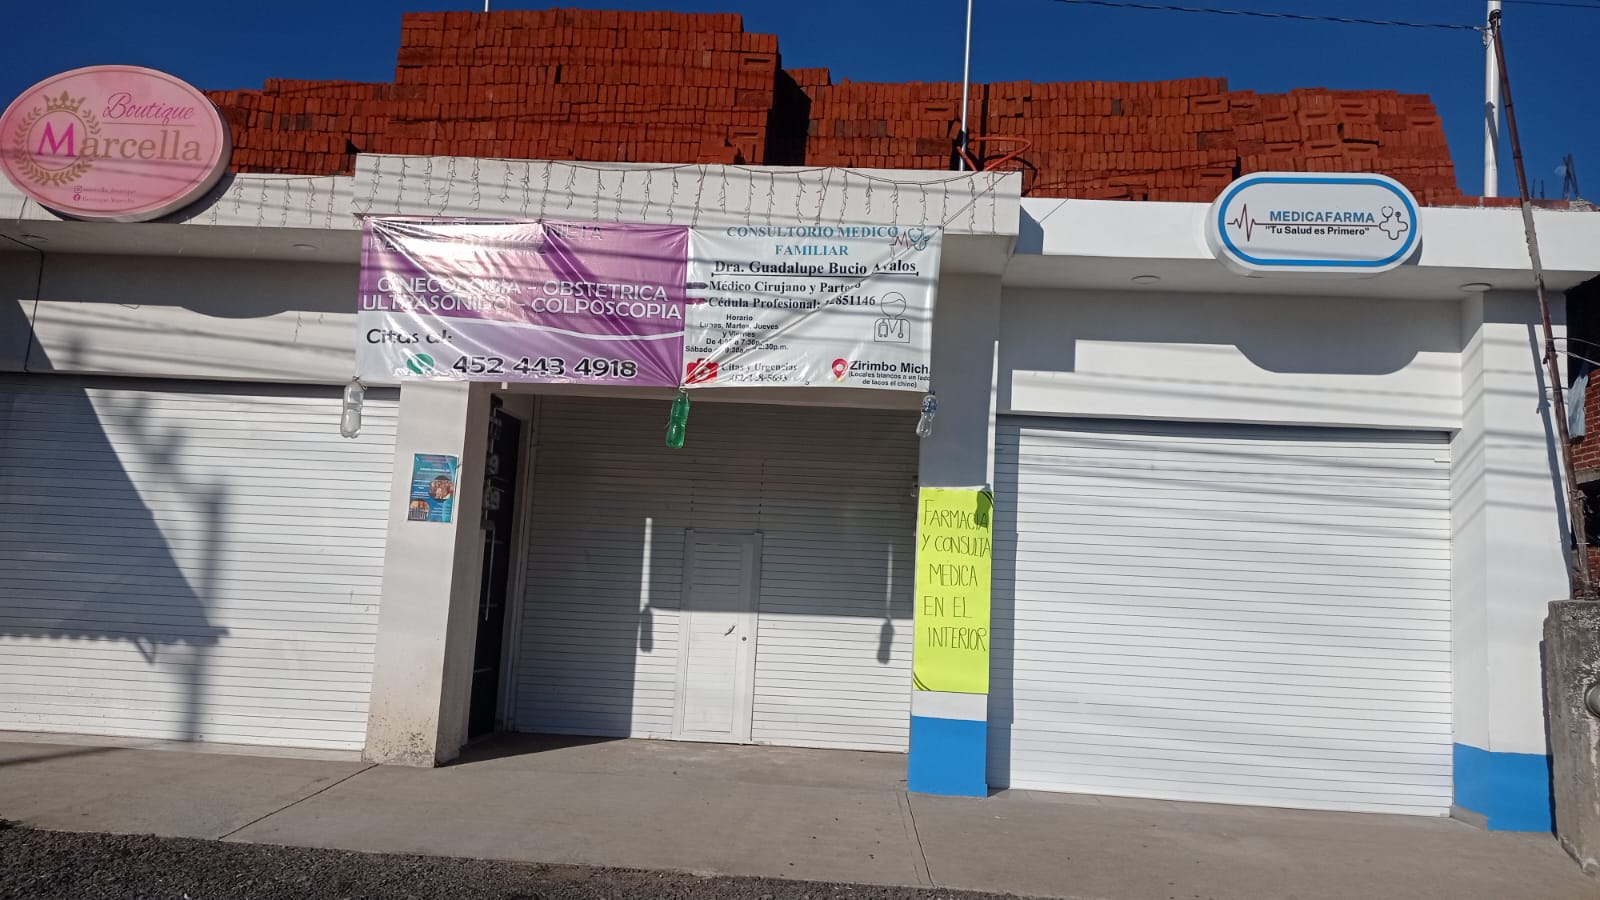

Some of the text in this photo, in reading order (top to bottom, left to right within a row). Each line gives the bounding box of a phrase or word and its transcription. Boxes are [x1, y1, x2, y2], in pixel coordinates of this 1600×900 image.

[103, 92, 193, 126] Boutique
[38, 121, 201, 160] Marcella
[1269, 211, 1375, 223] MEDICAFARMA
[727, 226, 899, 239] CONSULTORIO MEDICO
[1284, 226, 1312, 235] Salud
[1327, 227, 1370, 236] Primero"
[775, 245, 849, 256] FAMILIAR
[715, 261, 744, 273] Dra.
[750, 261, 824, 275] Guadalupe
[829, 262, 867, 274] Bucio
[543, 280, 668, 301] OBSTETRICA
[709, 281, 750, 292] Médico
[754, 281, 806, 295] Cirujano
[809, 285, 816, 294] y
[531, 296, 682, 320] COLPOSCOPIA
[708, 296, 749, 307] Cédula
[753, 298, 821, 309] Profesional:
[685, 345, 713, 353] Sábado
[452, 355, 638, 377] 452 443 4918
[849, 360, 897, 372] Zirimbo
[876, 372, 901, 380] blancos
[924, 499, 989, 532] FARMACIA
[922, 533, 991, 558] Y CONSULTA
[923, 596, 973, 618] EN EL
[928, 627, 987, 651] INTERIOR
